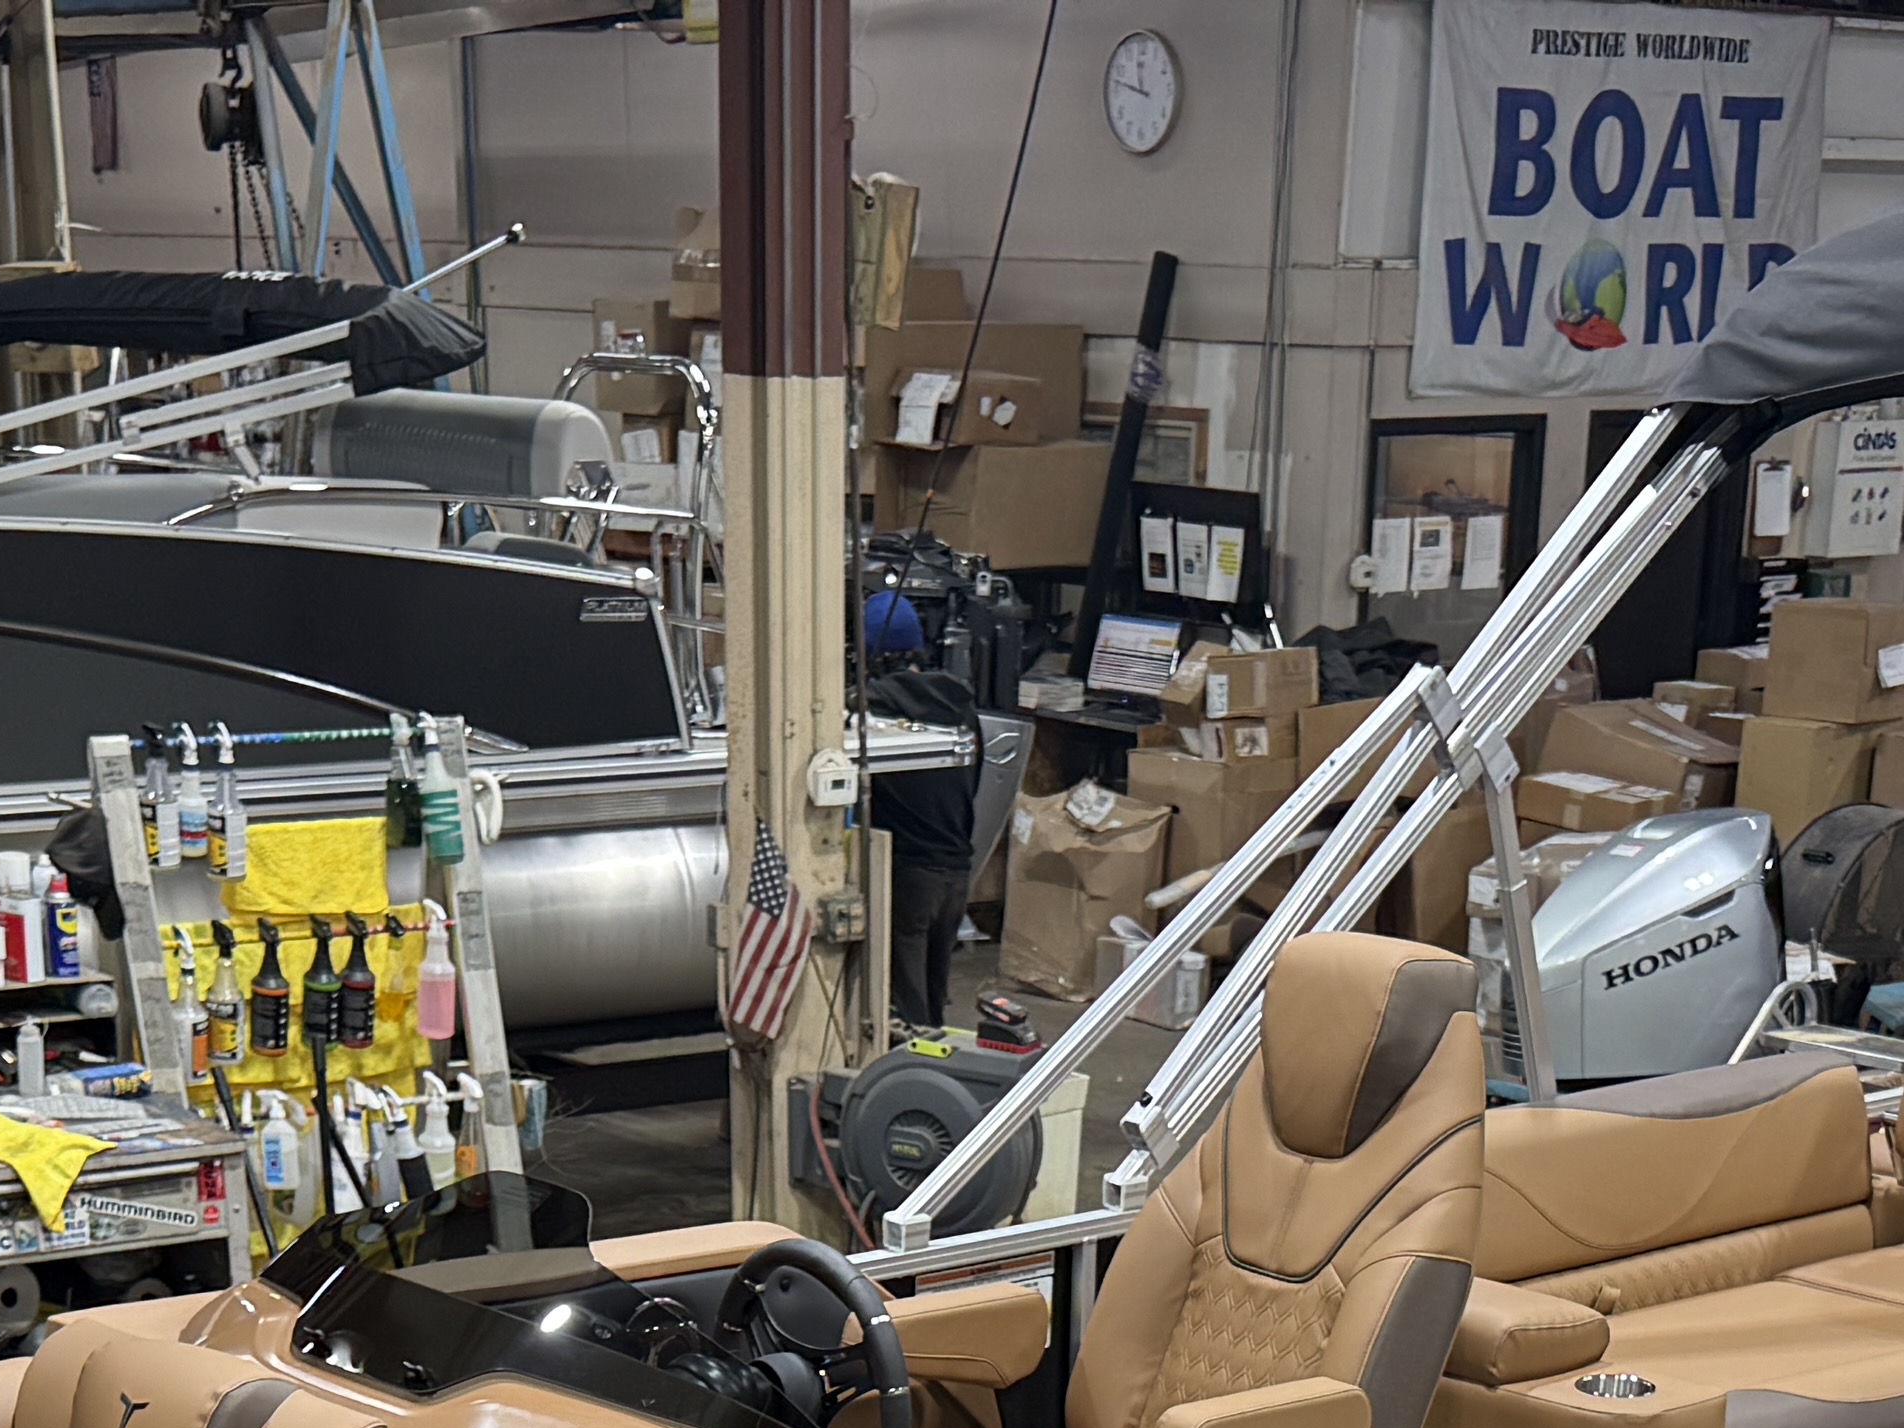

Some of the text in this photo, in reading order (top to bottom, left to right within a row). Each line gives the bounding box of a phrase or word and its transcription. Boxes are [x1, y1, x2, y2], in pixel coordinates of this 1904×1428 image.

[1531, 28, 1751, 64] PRESTIGE WORLDWIDE
[1487, 86, 1784, 219] BOAT
[1601, 924, 1741, 990] HONDA
[80, 1197, 195, 1225] HUMMINBIRD
